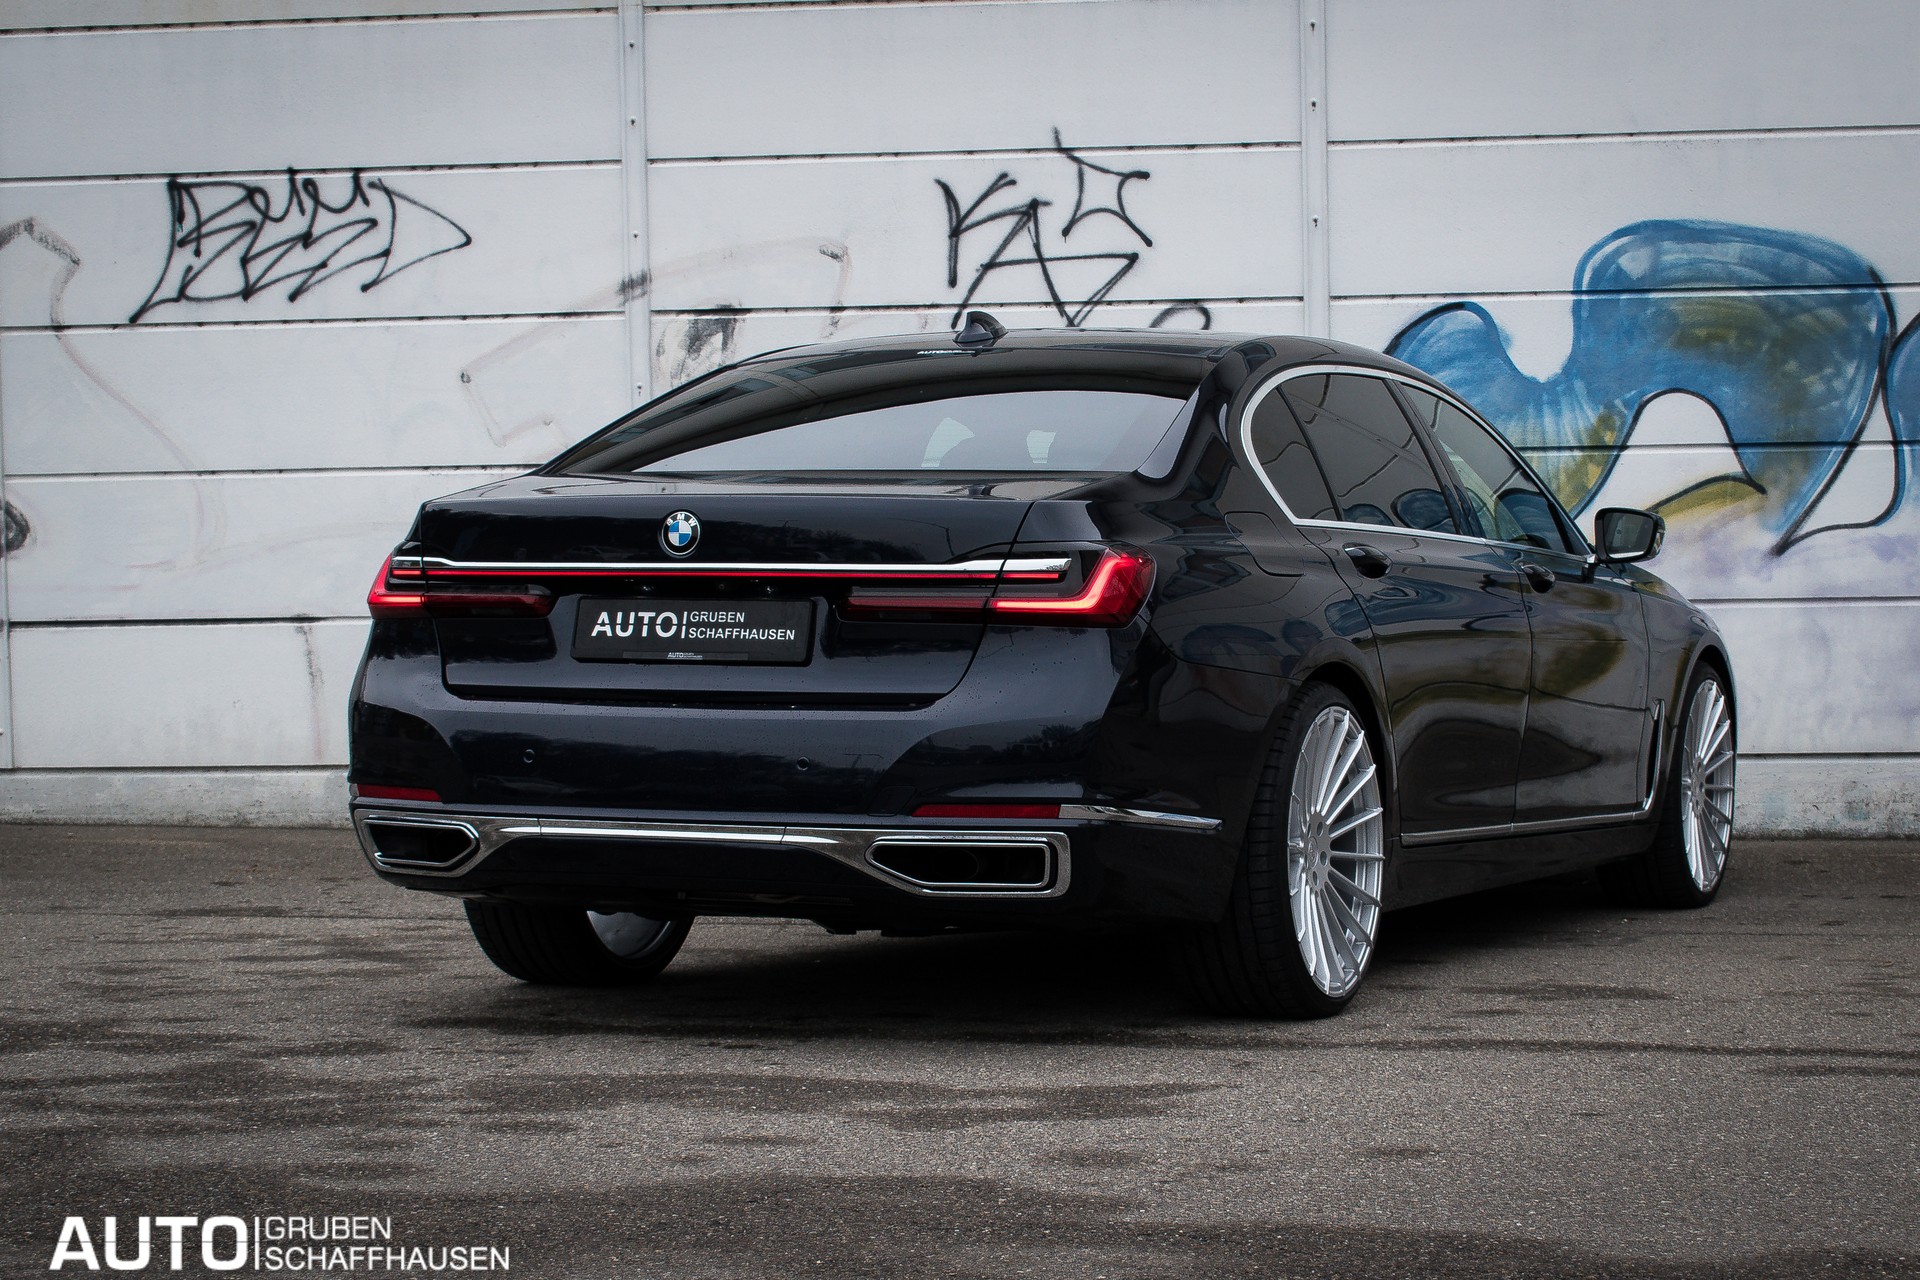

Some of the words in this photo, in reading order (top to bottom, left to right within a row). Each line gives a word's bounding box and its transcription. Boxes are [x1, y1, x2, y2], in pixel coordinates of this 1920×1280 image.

[666, 512, 697, 527] BMW
[689, 611, 745, 623] GRUBEN
[590, 611, 678, 638] AUTO
[688, 627, 795, 641] SCHAFFHAUSEN
